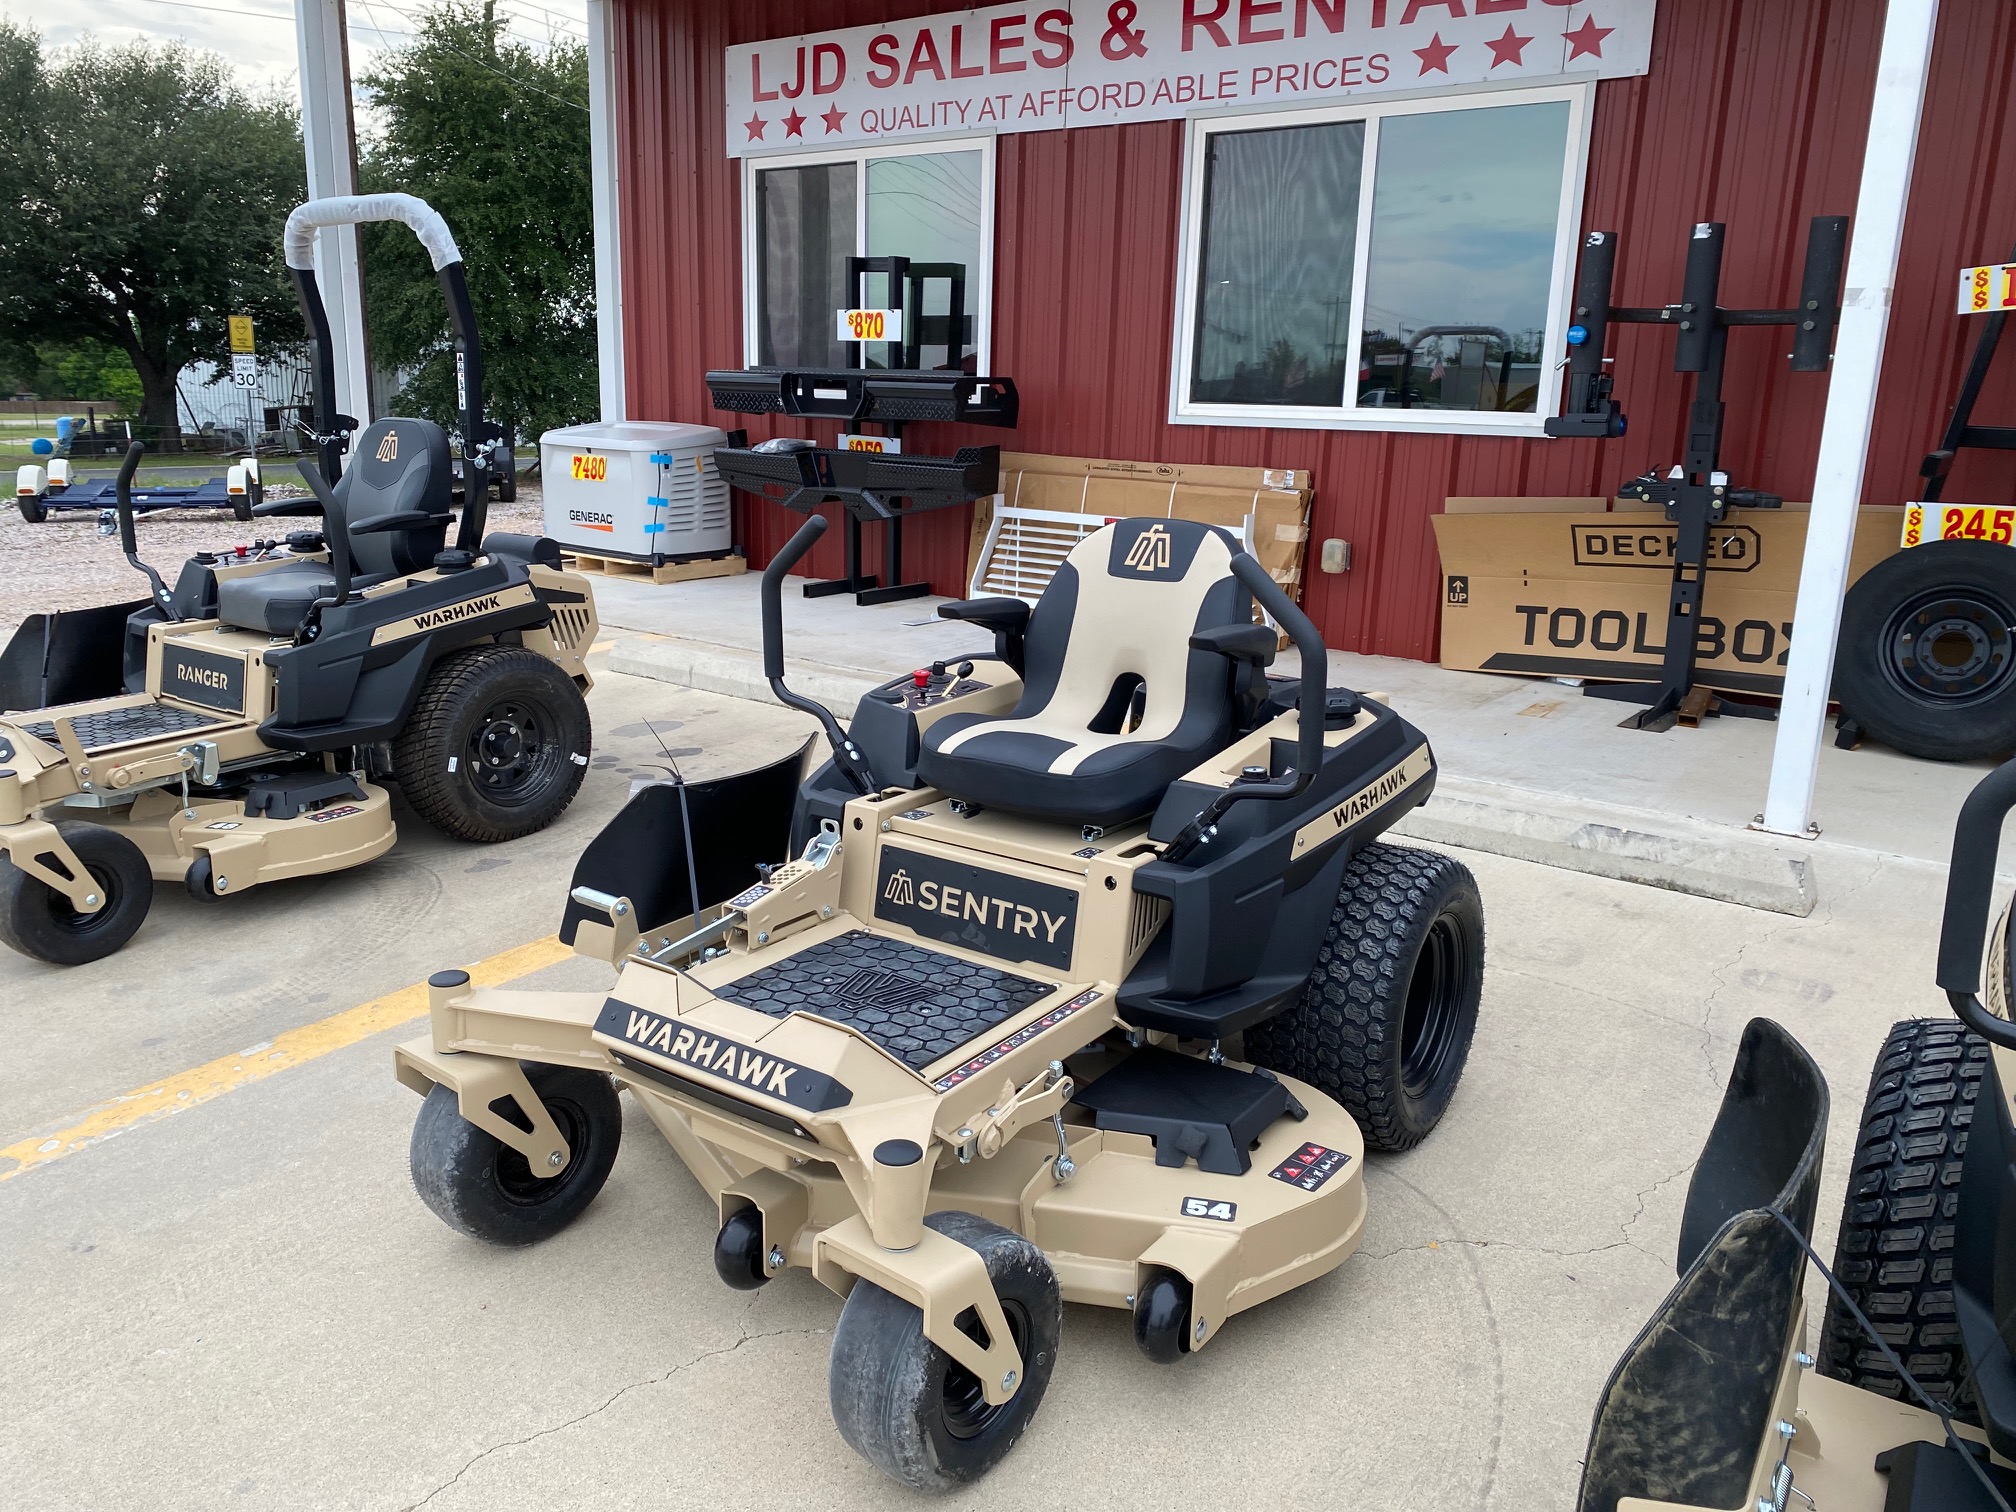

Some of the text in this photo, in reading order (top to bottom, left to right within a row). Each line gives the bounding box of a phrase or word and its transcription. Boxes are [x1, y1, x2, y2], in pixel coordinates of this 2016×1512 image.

[751, 42, 847, 103] LJD
[866, 8, 1075, 89] SALES
[1100, 0, 1149, 61] &
[860, 98, 972, 134] QUALITY
[977, 94, 1013, 123] AT
[1251, 53, 1391, 97] PRICES
[848, 312, 884, 339] $870
[236, 373, 256, 386] 30
[573, 456, 605, 480] 7480
[569, 509, 613, 525] GENERAC
[1944, 508, 2015, 545] 245
[413, 596, 501, 630] WARHAWK
[1449, 592, 1468, 602] UP
[1515, 605, 1667, 655] TOOL
[177, 663, 228, 691] RANGER
[1333, 765, 1407, 828] WARHAWK
[918, 880, 1068, 943] SENTRY
[624, 1010, 798, 1097] WARHAWK
[1185, 1198, 1232, 1220] 54
